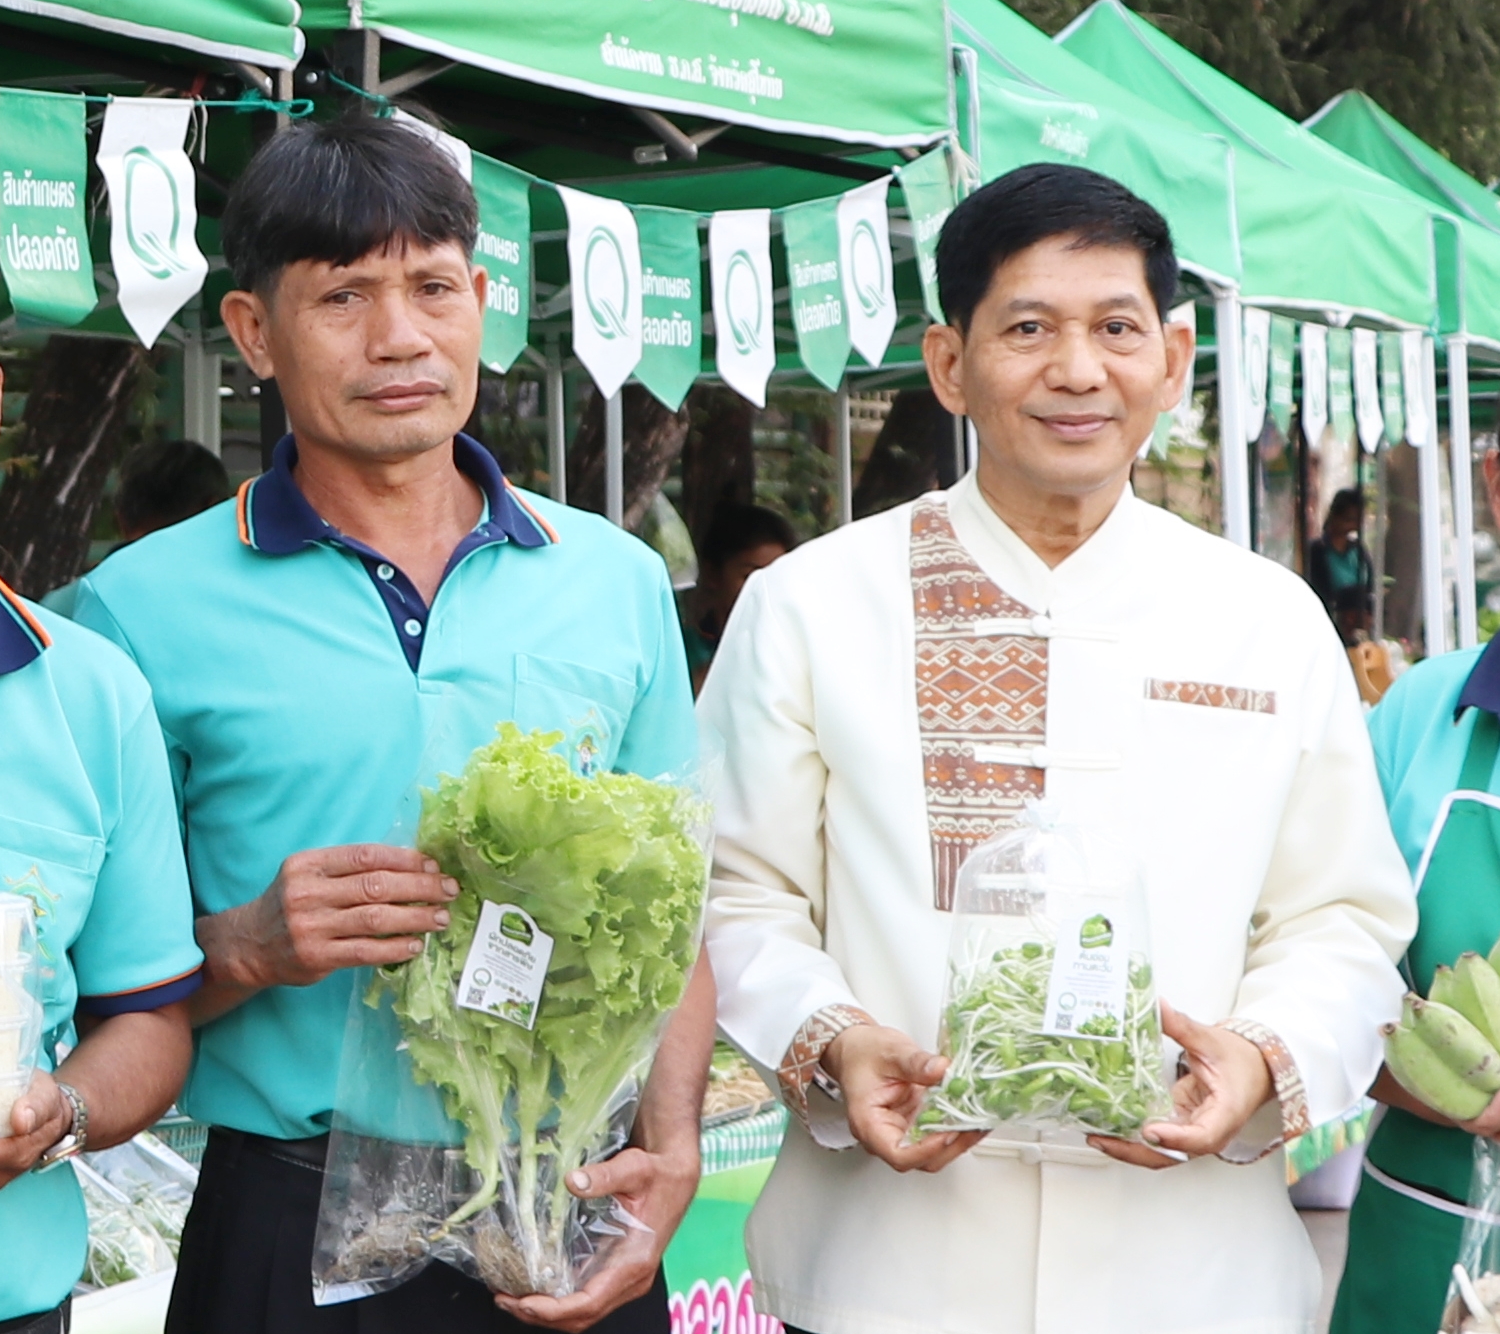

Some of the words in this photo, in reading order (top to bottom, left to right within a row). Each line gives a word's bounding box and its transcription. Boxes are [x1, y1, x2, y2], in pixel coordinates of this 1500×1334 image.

[2, 170, 75, 209] สินค้าเกษตร
[4, 222, 80, 273] ปลอดภัย
[642, 311, 693, 348] ลอดภัย
